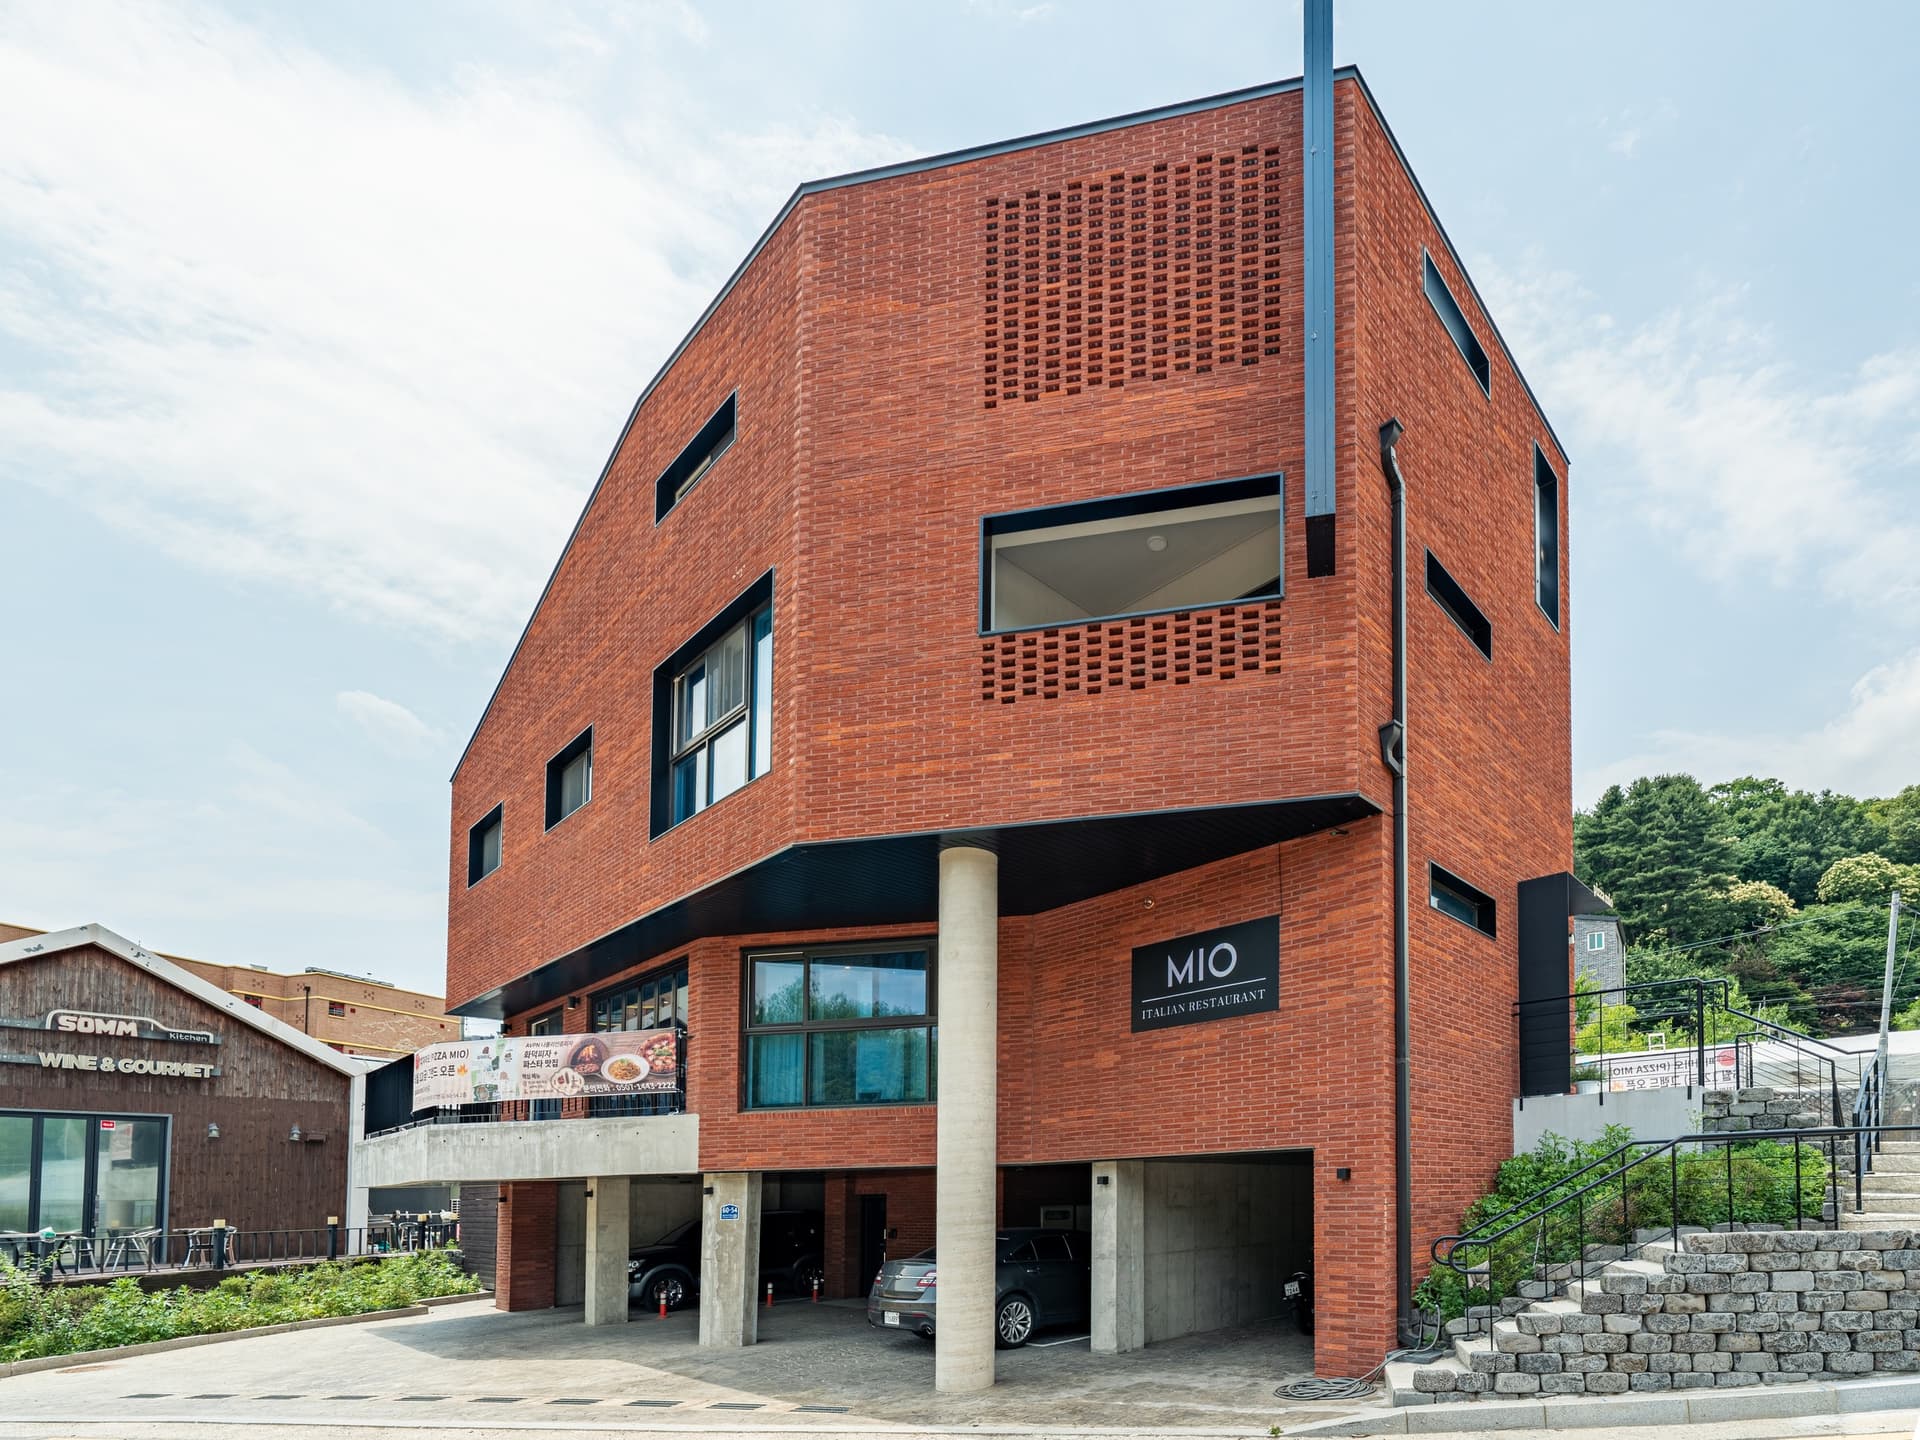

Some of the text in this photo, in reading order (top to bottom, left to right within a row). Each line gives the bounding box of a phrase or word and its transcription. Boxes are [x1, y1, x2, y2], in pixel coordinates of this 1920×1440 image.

[1167, 942, 1238, 988] MIO
[1142, 989, 1266, 1020] ITALIAN RESTAURANT
[57, 1014, 138, 1037] SOMM
[169, 1032, 208, 1042] Kitchen
[38, 1051, 214, 1078] WINE & GOURMET
[523, 1060, 543, 1069] 파스타
